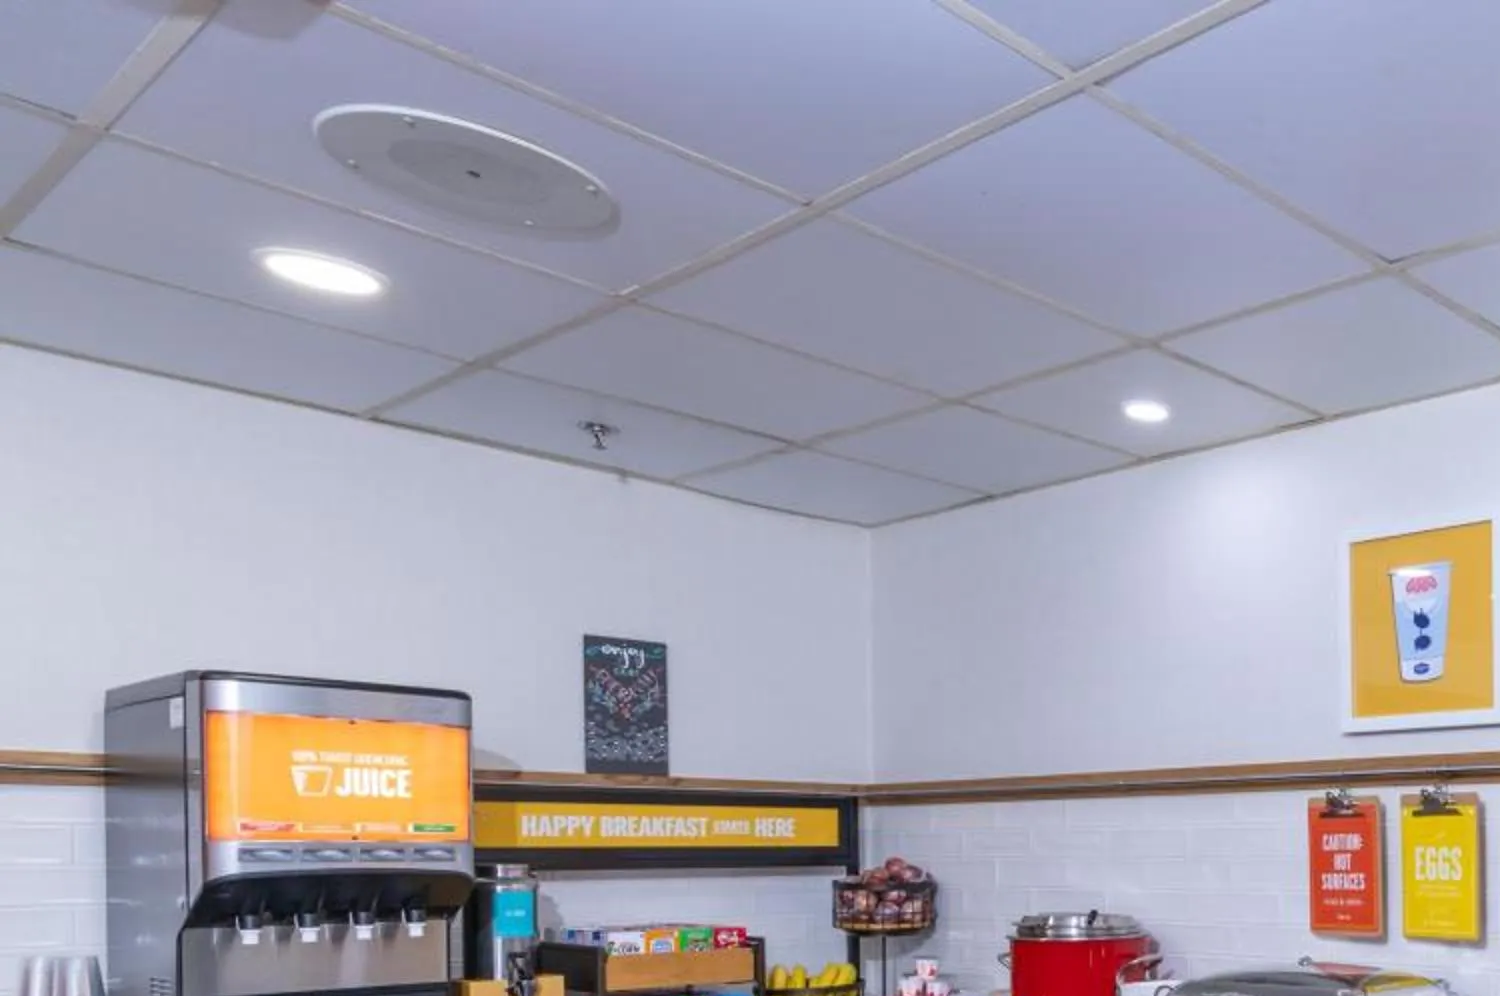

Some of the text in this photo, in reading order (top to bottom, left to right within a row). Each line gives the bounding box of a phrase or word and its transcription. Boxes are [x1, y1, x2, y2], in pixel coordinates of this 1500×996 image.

[335, 767, 412, 798] JUICE
[521, 815, 595, 838] HAPPY
[600, 815, 709, 838] BREAKFAST
[755, 817, 796, 837] HERE
[1333, 853, 1351, 871] HOT
[1414, 846, 1463, 881] EGGS
